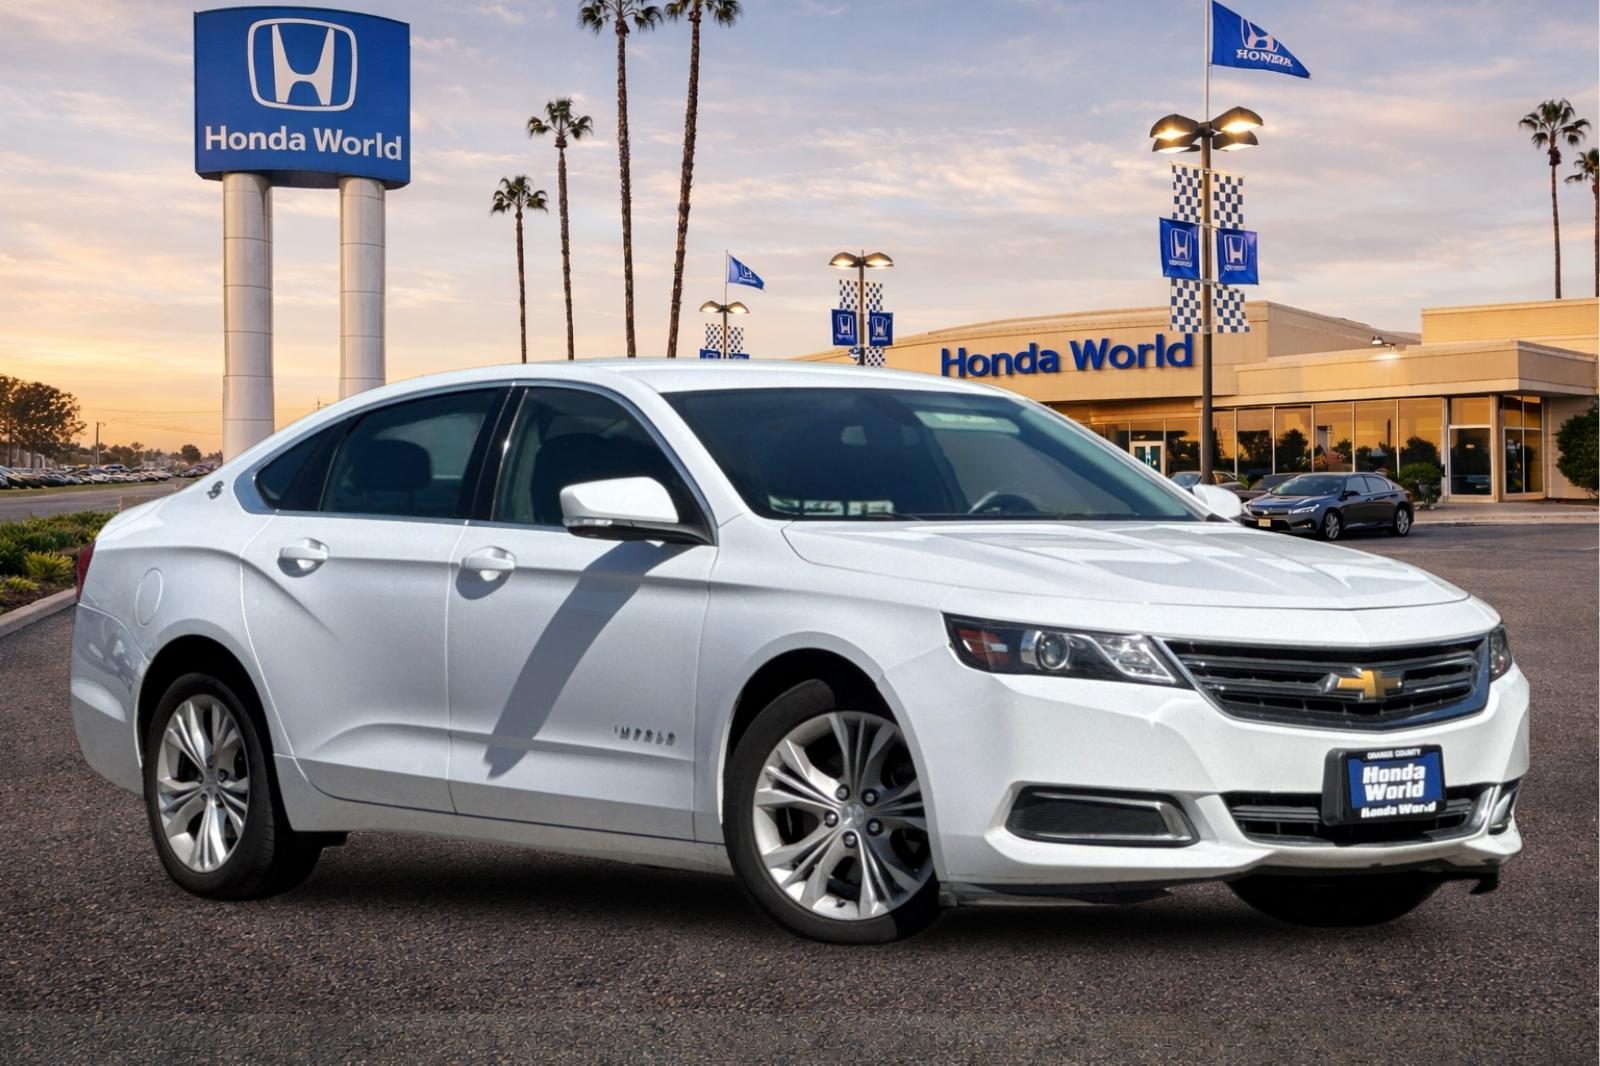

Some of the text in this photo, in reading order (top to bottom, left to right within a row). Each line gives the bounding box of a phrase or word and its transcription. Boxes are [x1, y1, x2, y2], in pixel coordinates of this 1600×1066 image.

[205, 125, 402, 161] Honda World
[941, 333, 1193, 378] Honda World
[1362, 763, 1426, 784] Honda
[1365, 780, 1425, 801] World
